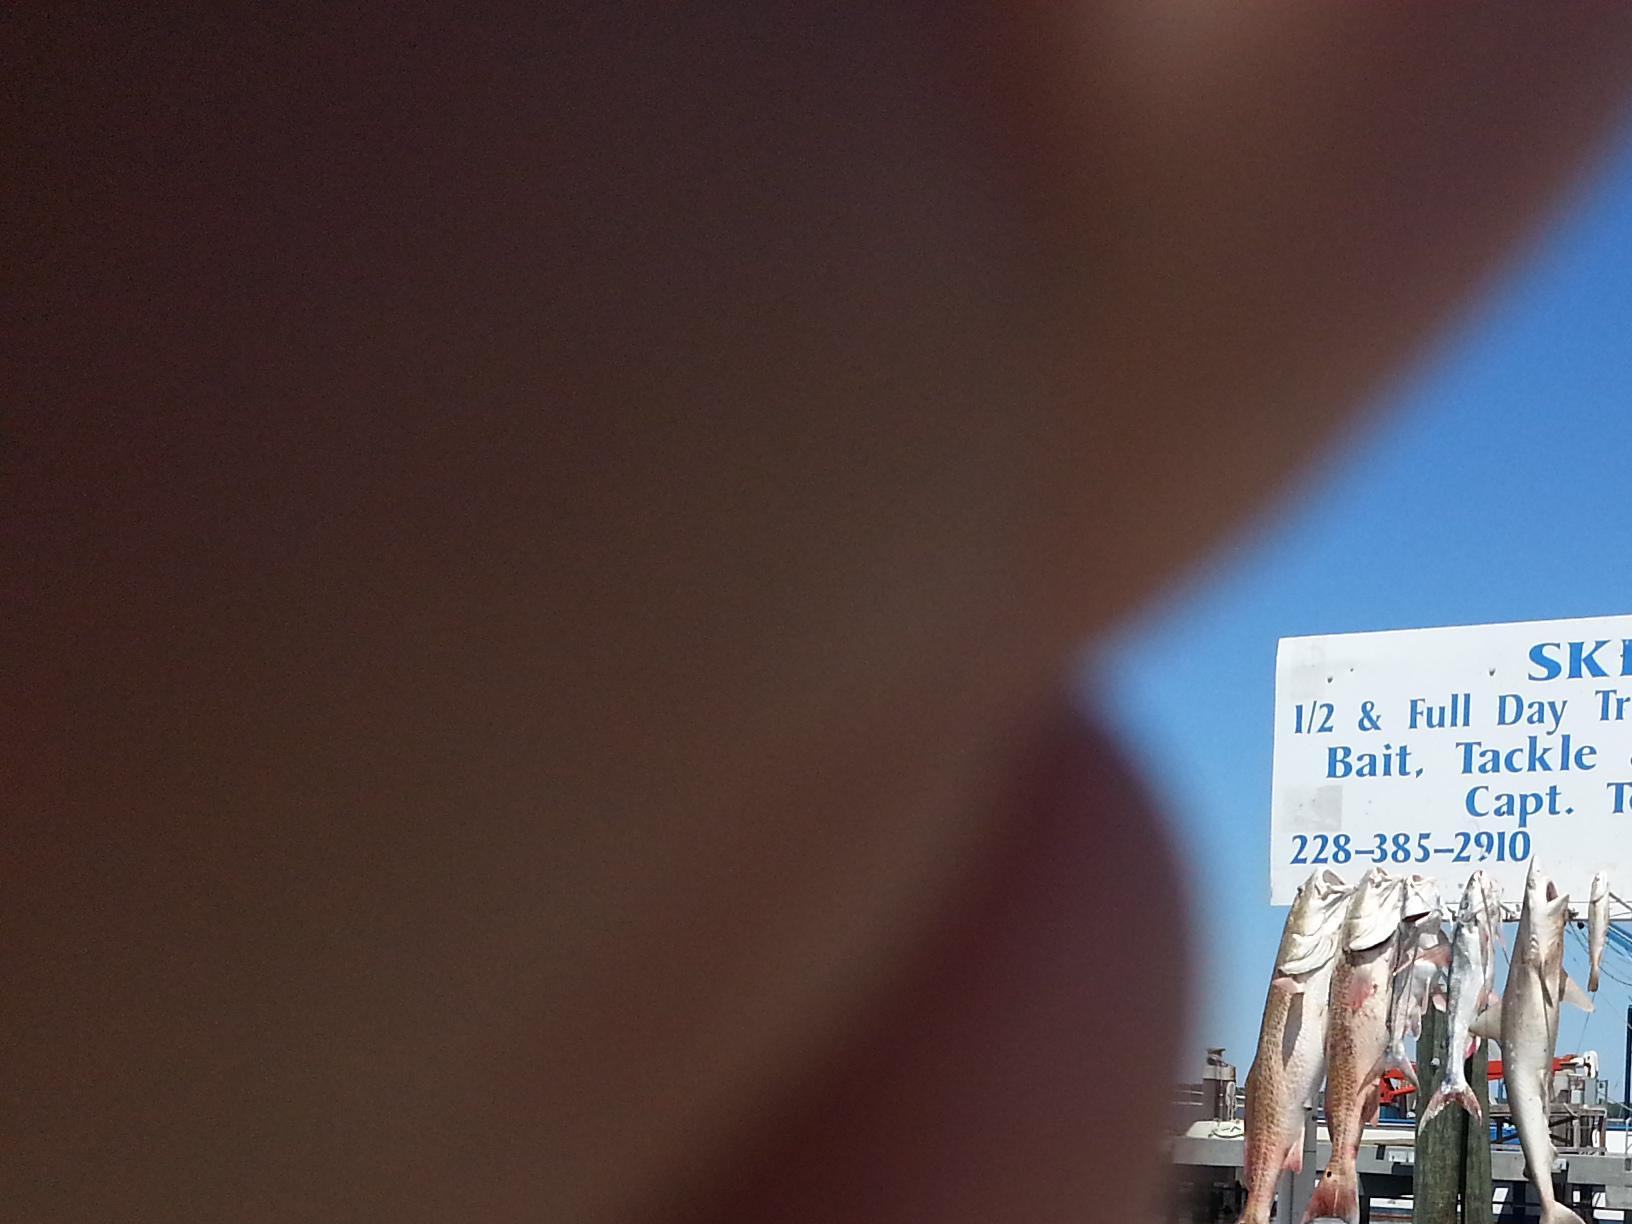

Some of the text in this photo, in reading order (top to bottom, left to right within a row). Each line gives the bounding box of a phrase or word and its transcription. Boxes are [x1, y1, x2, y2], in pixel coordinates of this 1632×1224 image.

[1294, 701, 1335, 734] 1/2
[1357, 700, 1382, 732] &
[1408, 693, 1471, 730] Full
[1497, 694, 1568, 735] Day
[1326, 744, 1423, 779] Bait,
[1456, 734, 1597, 775] Tackle
[1465, 785, 1574, 828] Capt.
[1290, 830, 1531, 864] 228-385-2910
